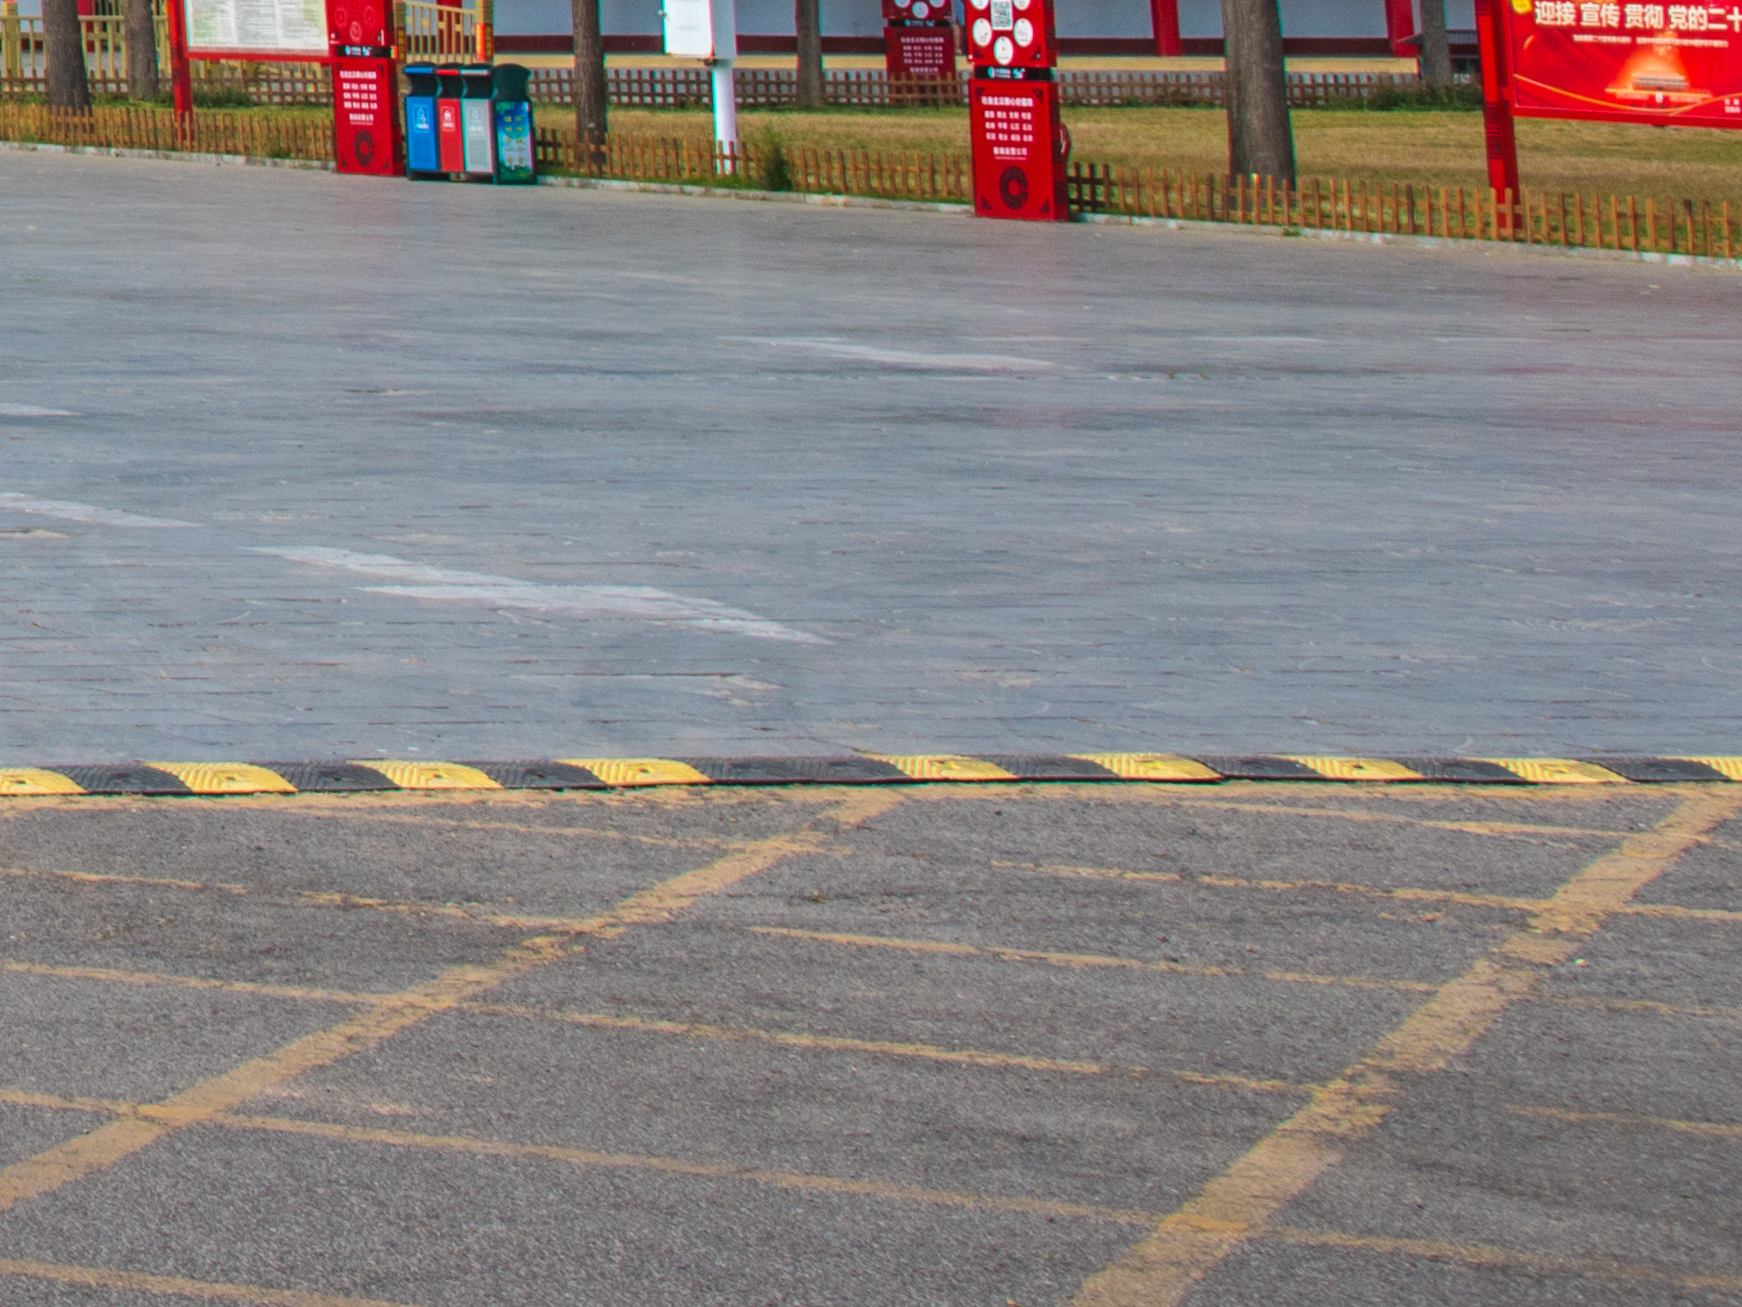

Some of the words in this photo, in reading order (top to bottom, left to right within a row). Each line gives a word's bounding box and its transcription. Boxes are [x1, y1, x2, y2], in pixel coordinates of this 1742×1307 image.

[1535, 0, 1576, 26] 迎接
[1580, 2, 1620, 28] 宣传
[1624, 4, 1664, 30] 贯彻
